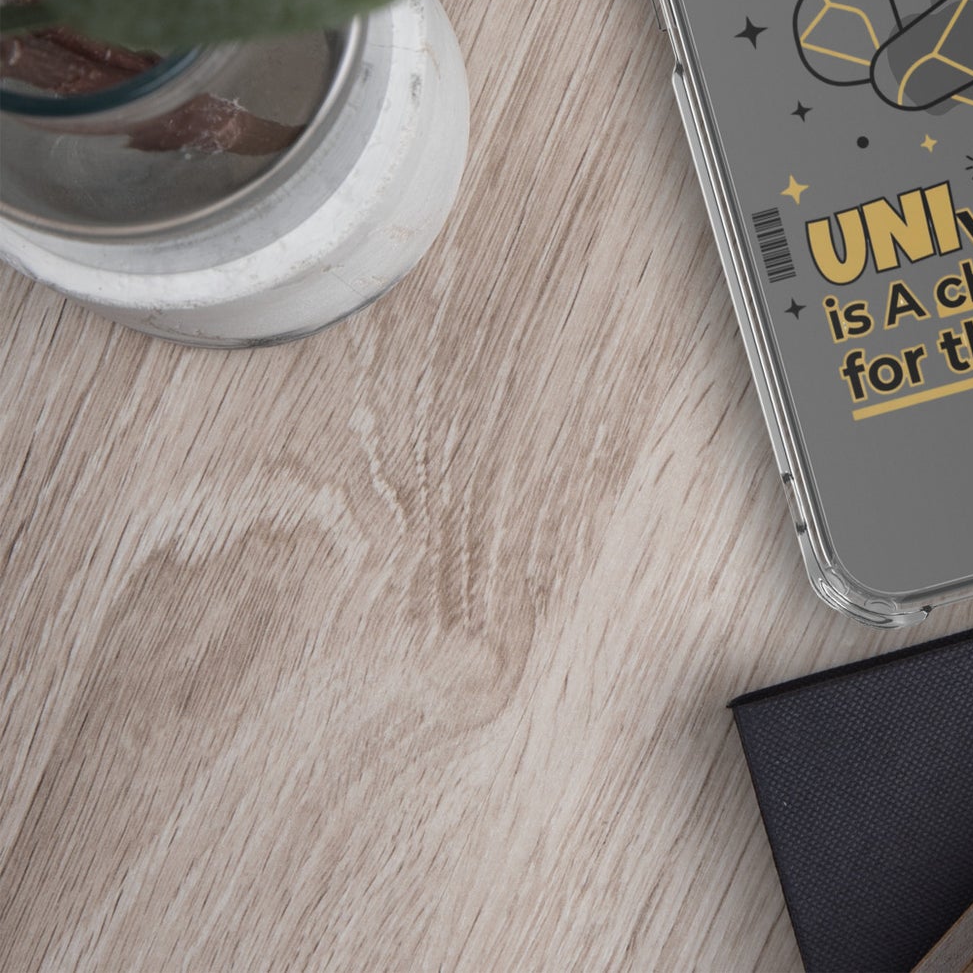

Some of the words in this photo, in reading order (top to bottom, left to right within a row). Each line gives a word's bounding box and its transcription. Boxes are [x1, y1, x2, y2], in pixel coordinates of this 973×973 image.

[823, 295, 874, 344] is
[884, 279, 931, 329] A
[840, 347, 928, 402] for
